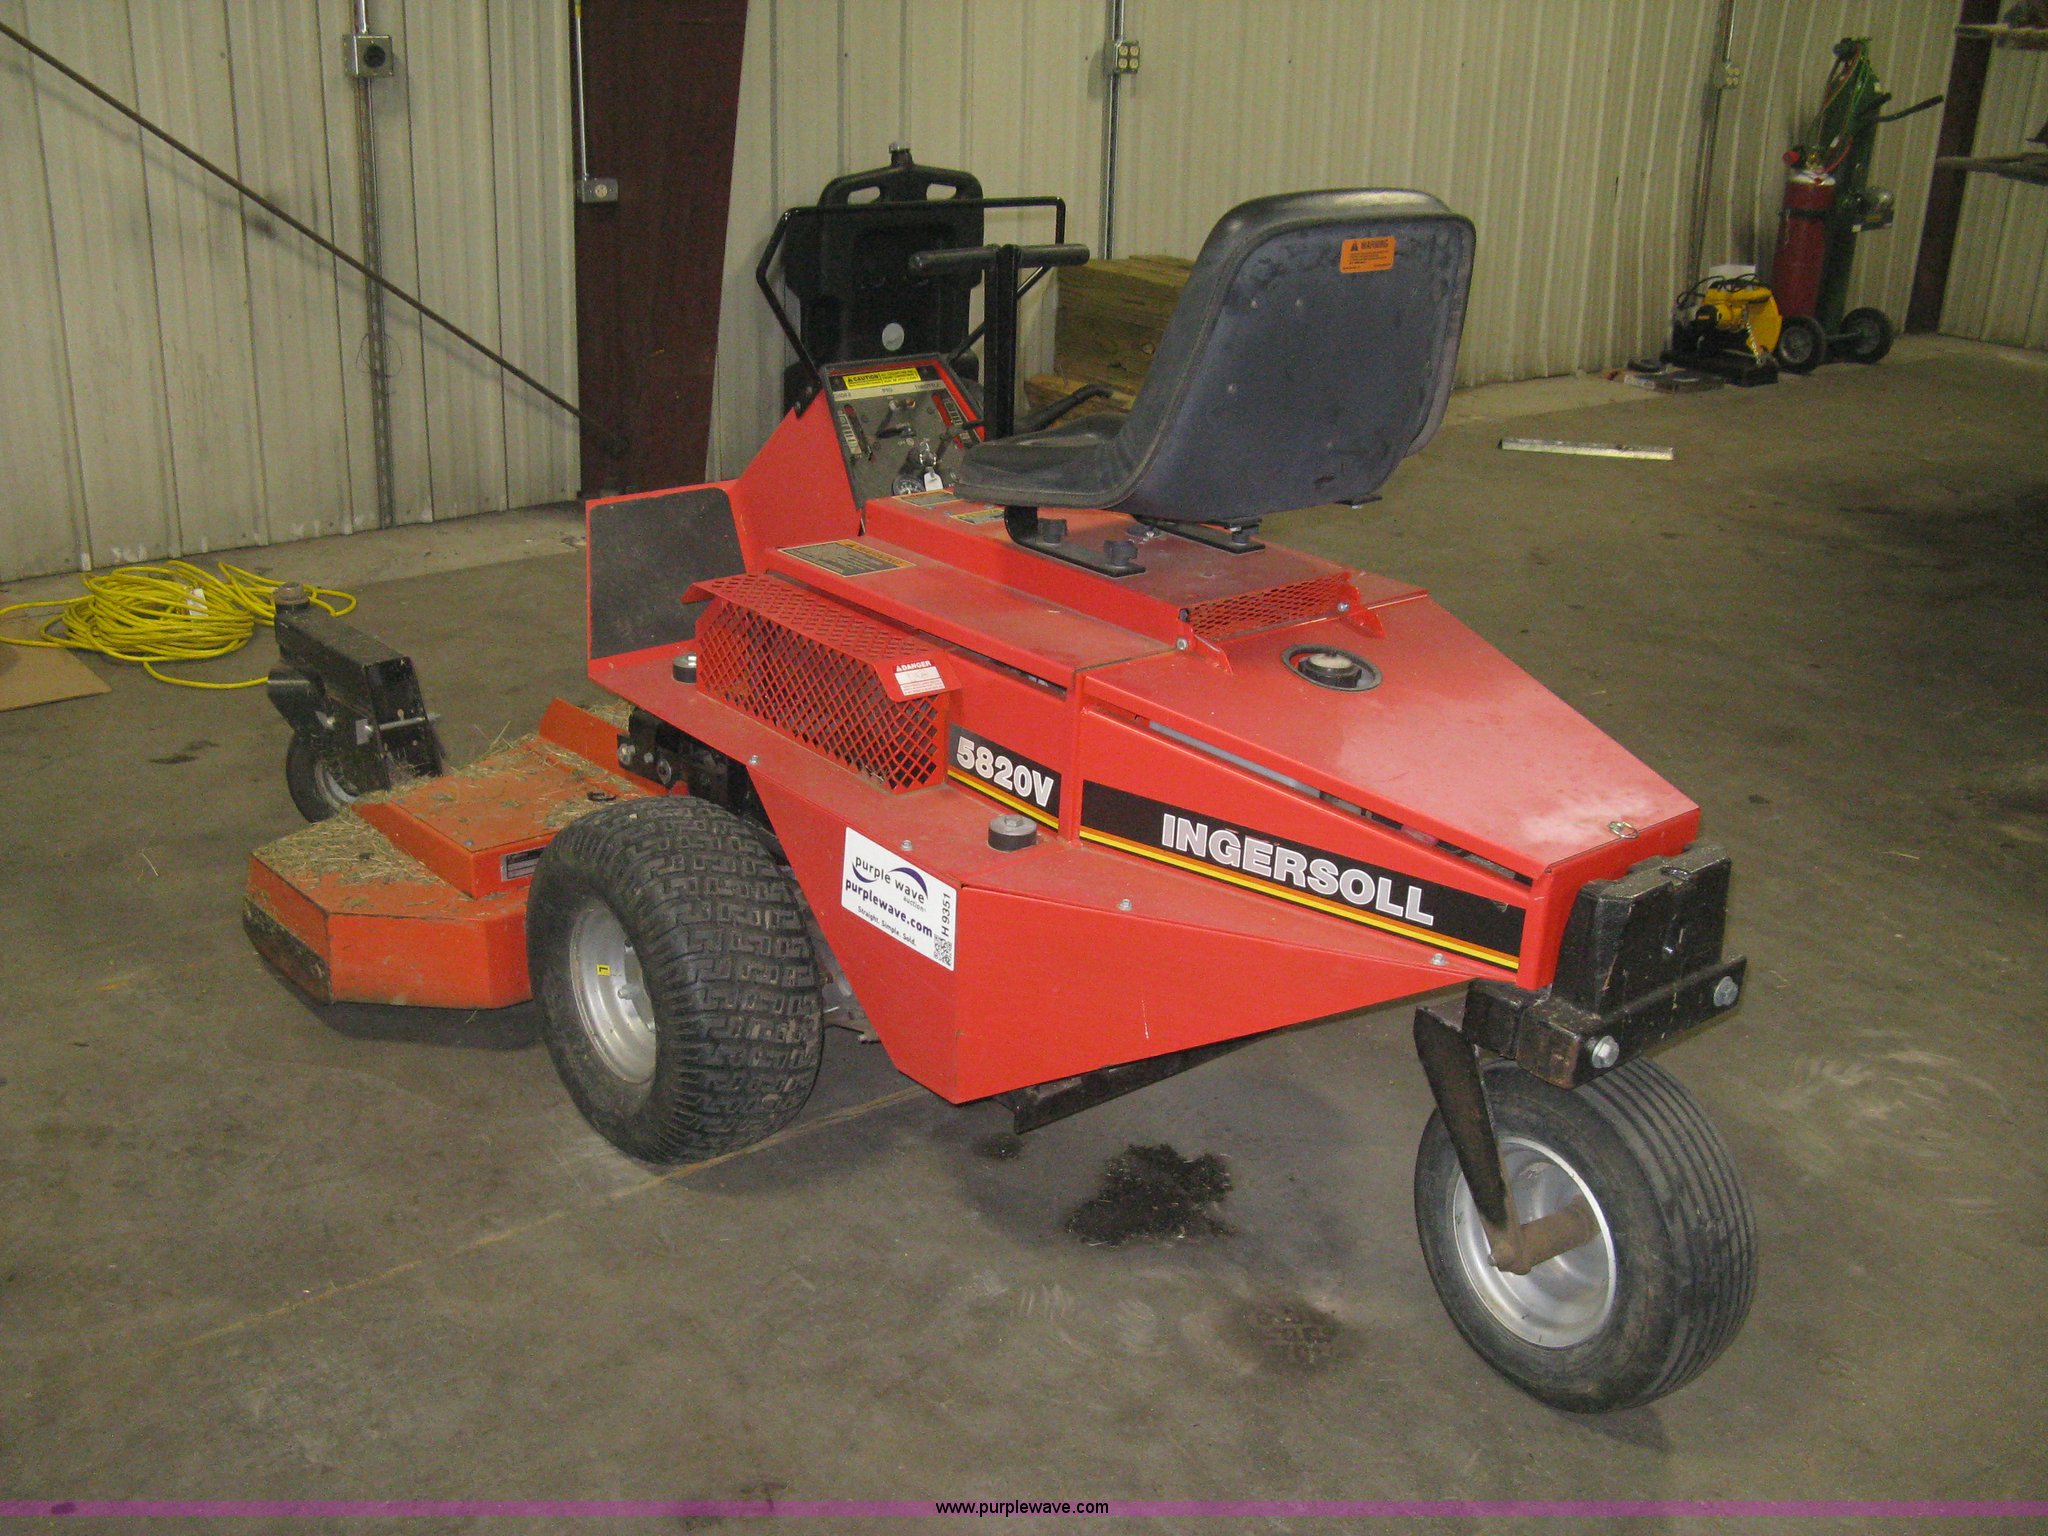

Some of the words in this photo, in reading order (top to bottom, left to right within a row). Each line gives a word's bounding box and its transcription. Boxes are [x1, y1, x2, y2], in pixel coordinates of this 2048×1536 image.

[901, 660, 932, 671] DANGER
[956, 736, 1054, 807] 5820V
[855, 856, 891, 884] purple
[894, 879, 925, 904] wave
[1161, 813, 1434, 926] INGERSOLL
[845, 878, 933, 938] purplewave.com
[858, 905, 879, 925] Straight.
[903, 897, 924, 912] auction
